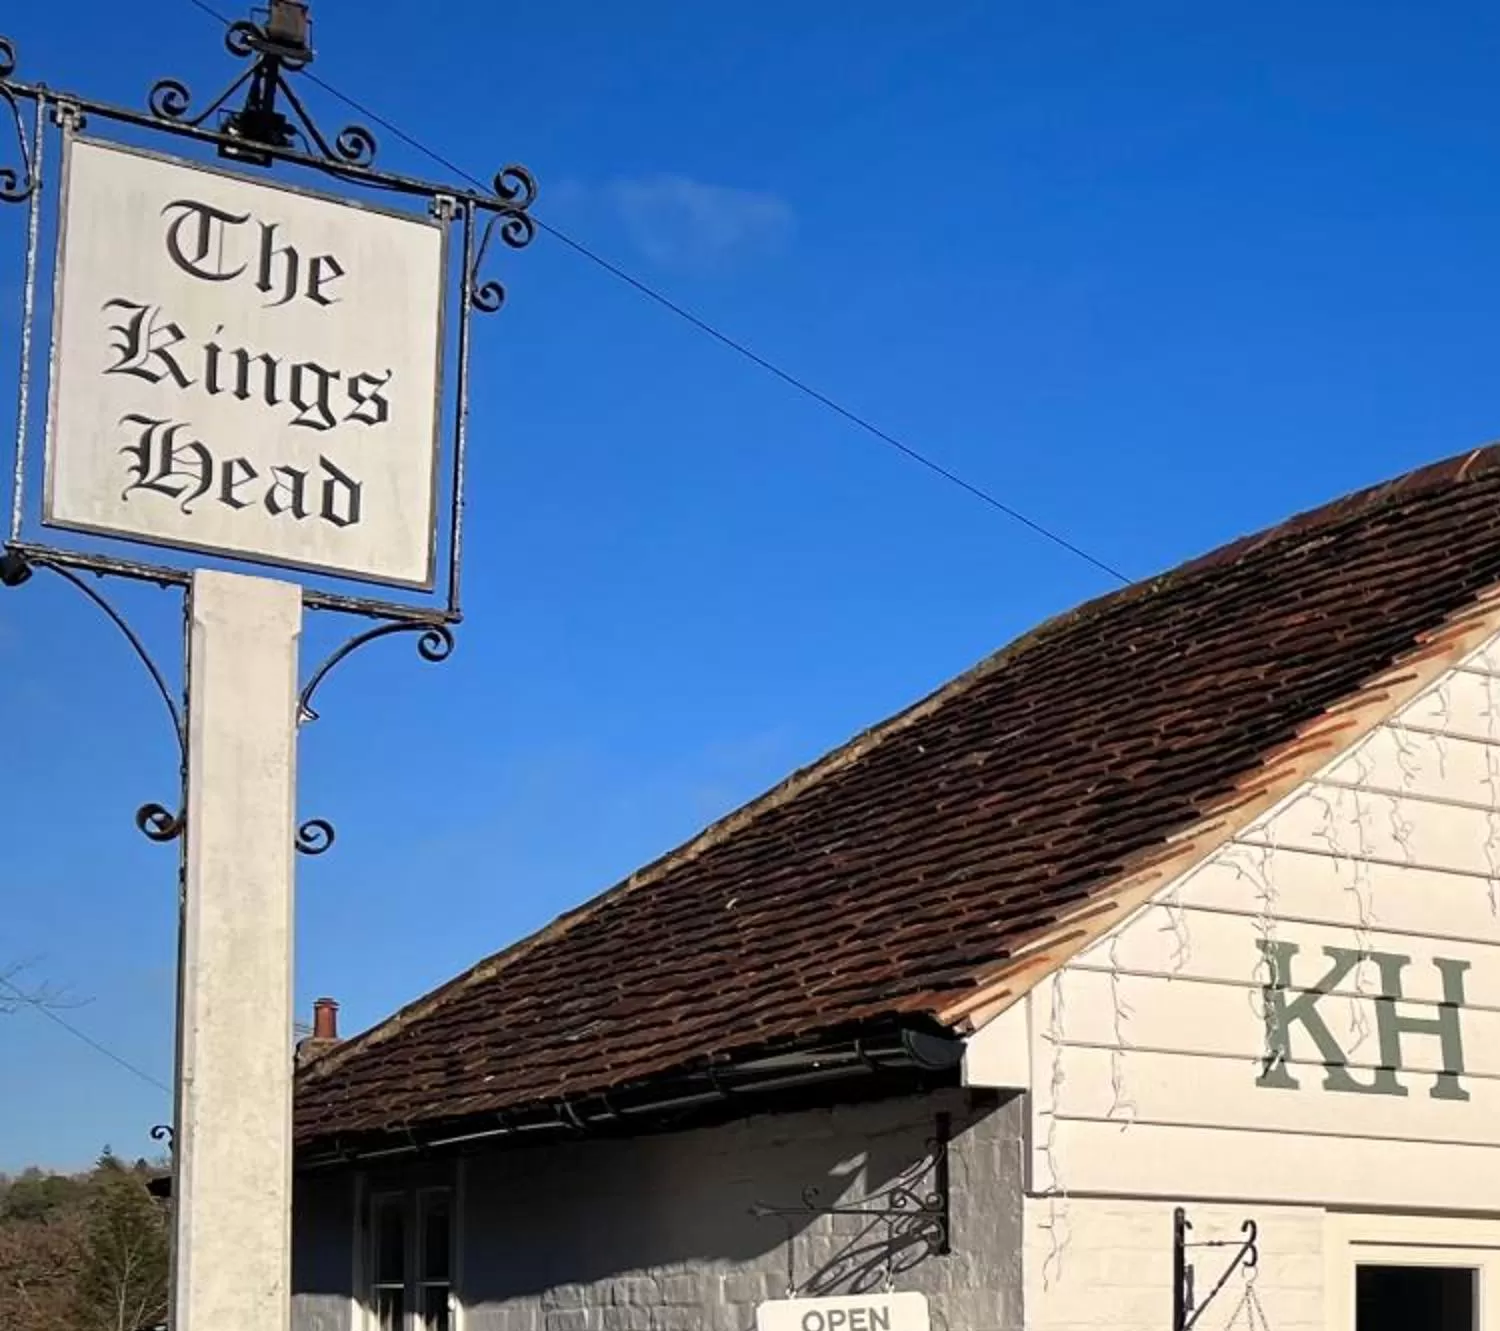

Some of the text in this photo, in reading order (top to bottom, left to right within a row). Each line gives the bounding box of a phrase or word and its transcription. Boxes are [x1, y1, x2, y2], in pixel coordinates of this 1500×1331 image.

[161, 199, 346, 307] The
[101, 298, 393, 431] Kings
[118, 414, 364, 528] Head
[1255, 938, 1472, 1101] KH
